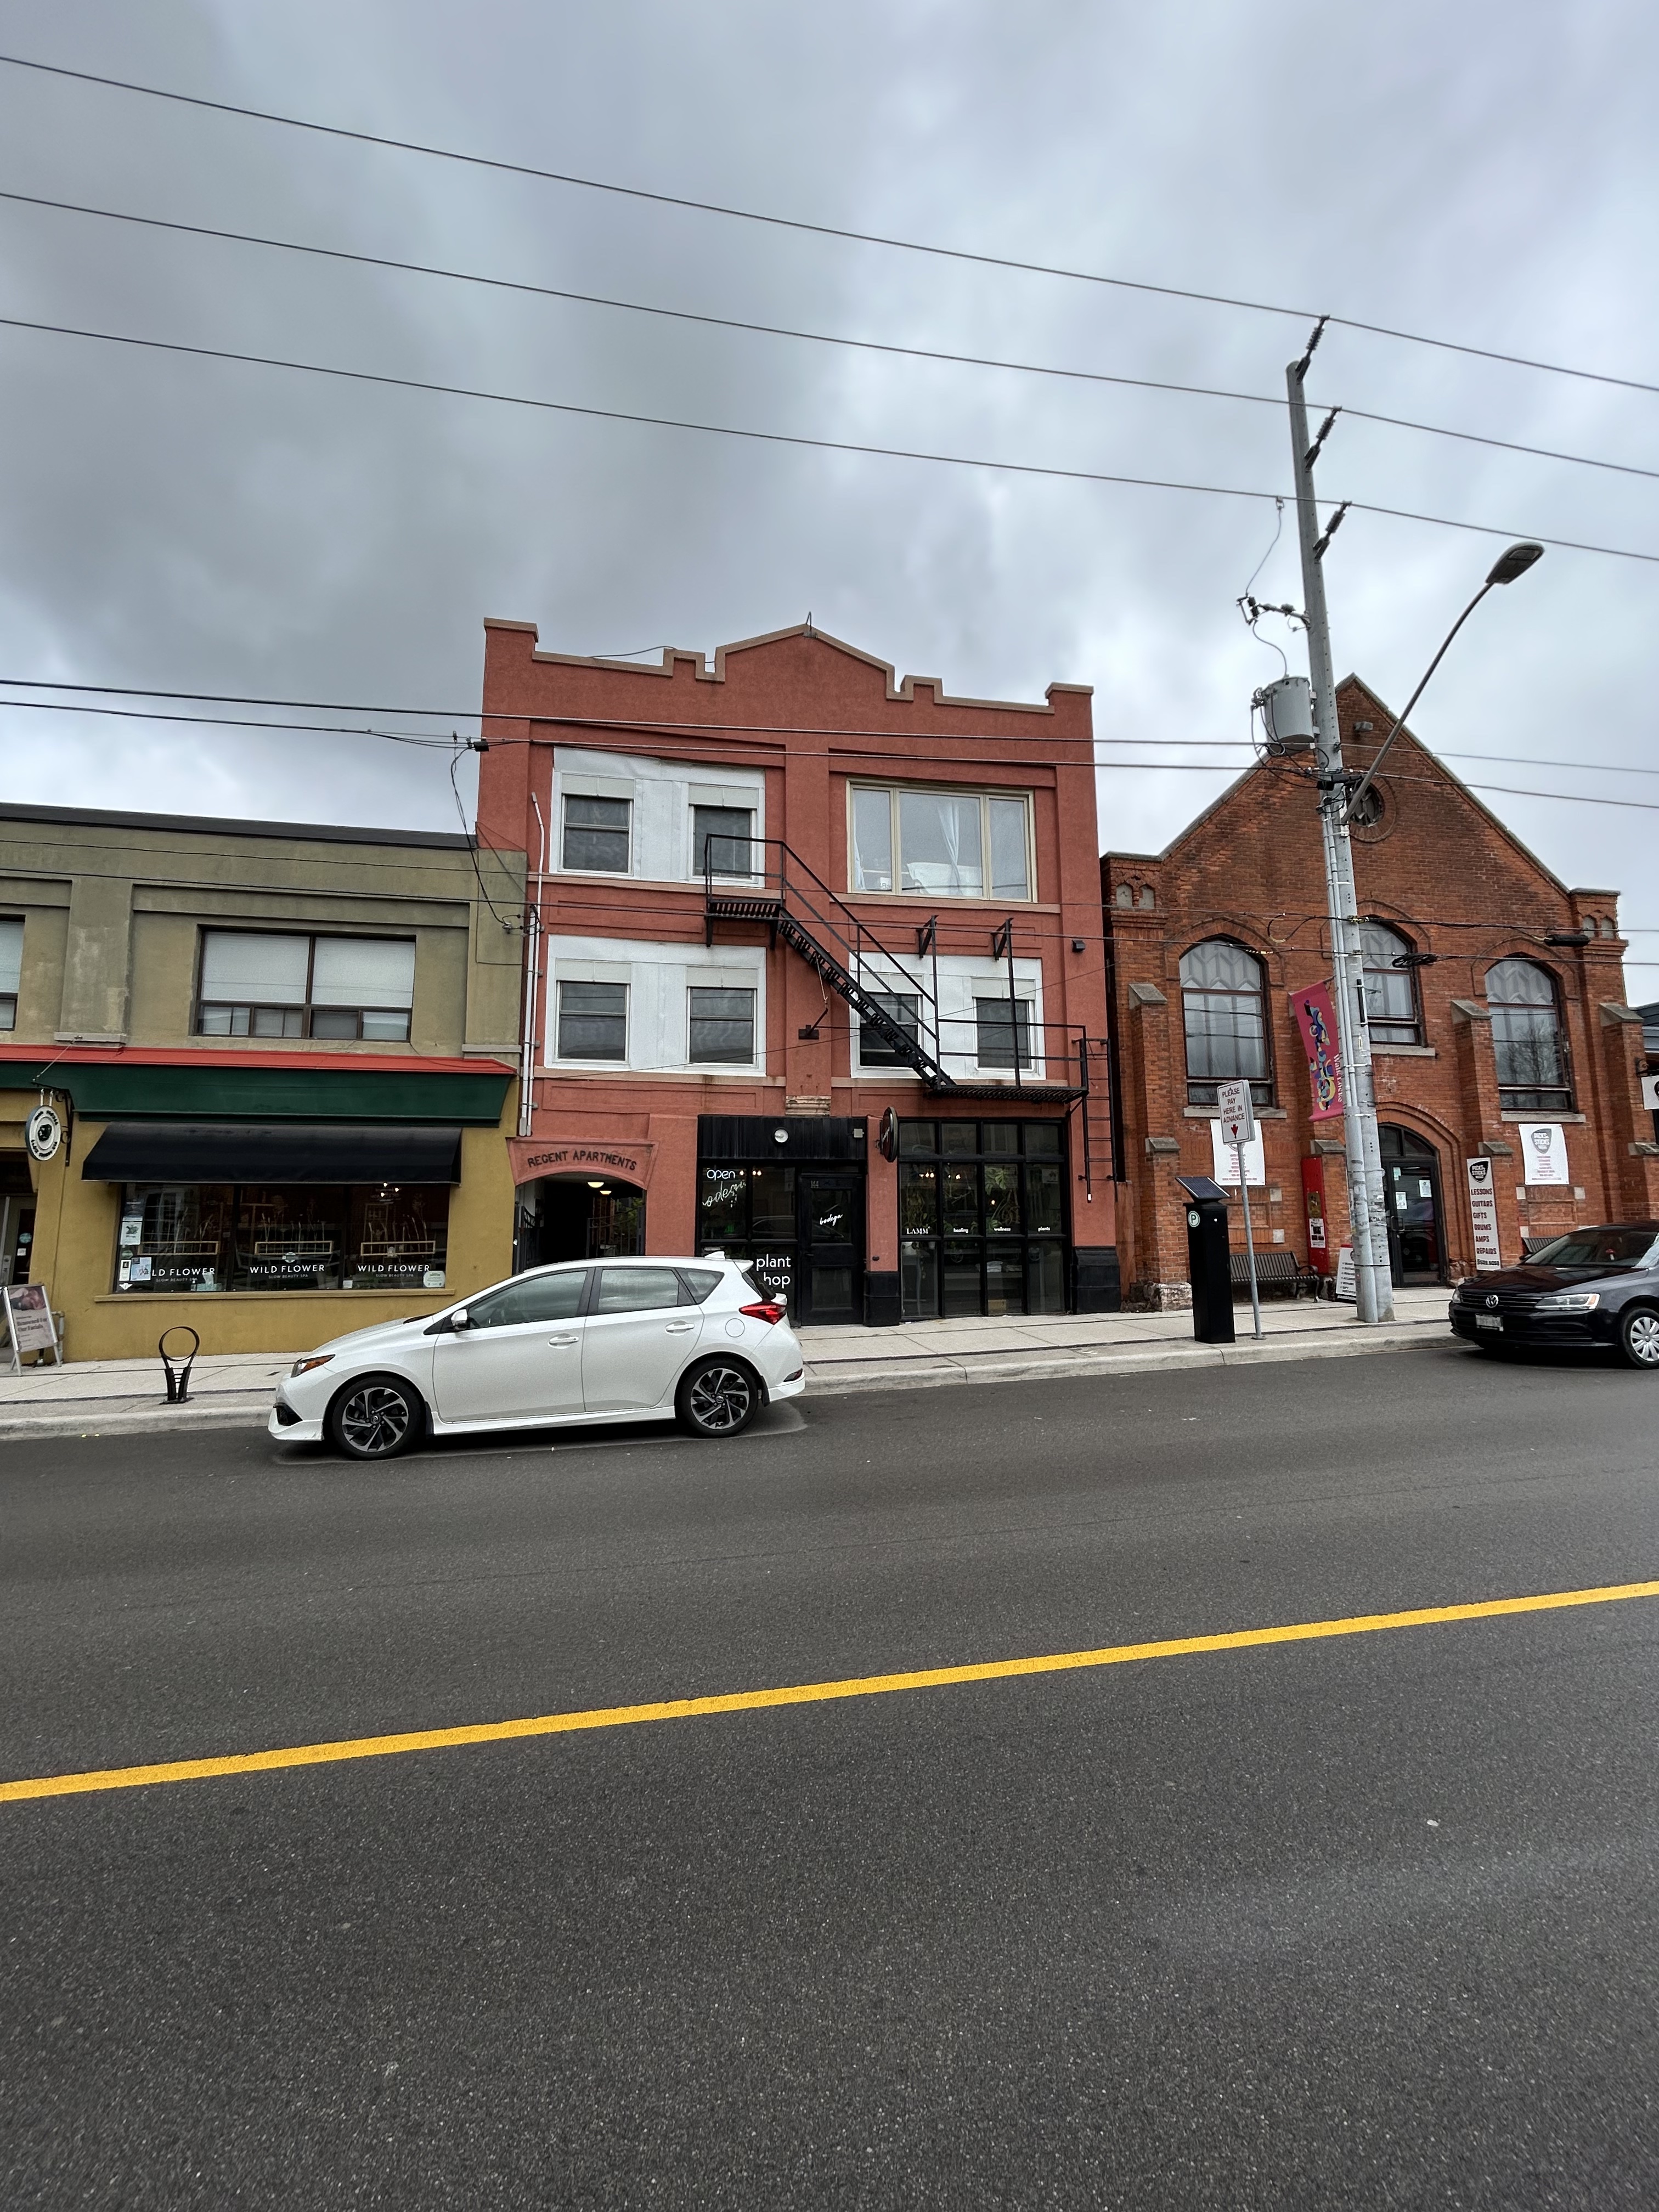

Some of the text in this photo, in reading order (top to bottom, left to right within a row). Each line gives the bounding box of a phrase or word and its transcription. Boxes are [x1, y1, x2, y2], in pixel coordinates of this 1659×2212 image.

[1222, 1087, 1240, 1098] PLEASE
[1223, 1113, 1245, 1124] ADVANCE
[528, 1150, 637, 1171] REGENT APARTMENTS
[707, 1170, 735, 1181] open
[819, 1214, 843, 1226] bodega
[757, 1254, 791, 1272] plant
[170, 1267, 215, 1276] FLOWER
[281, 1265, 325, 1273] FLOWER
[763, 1272, 791, 1289] hop
